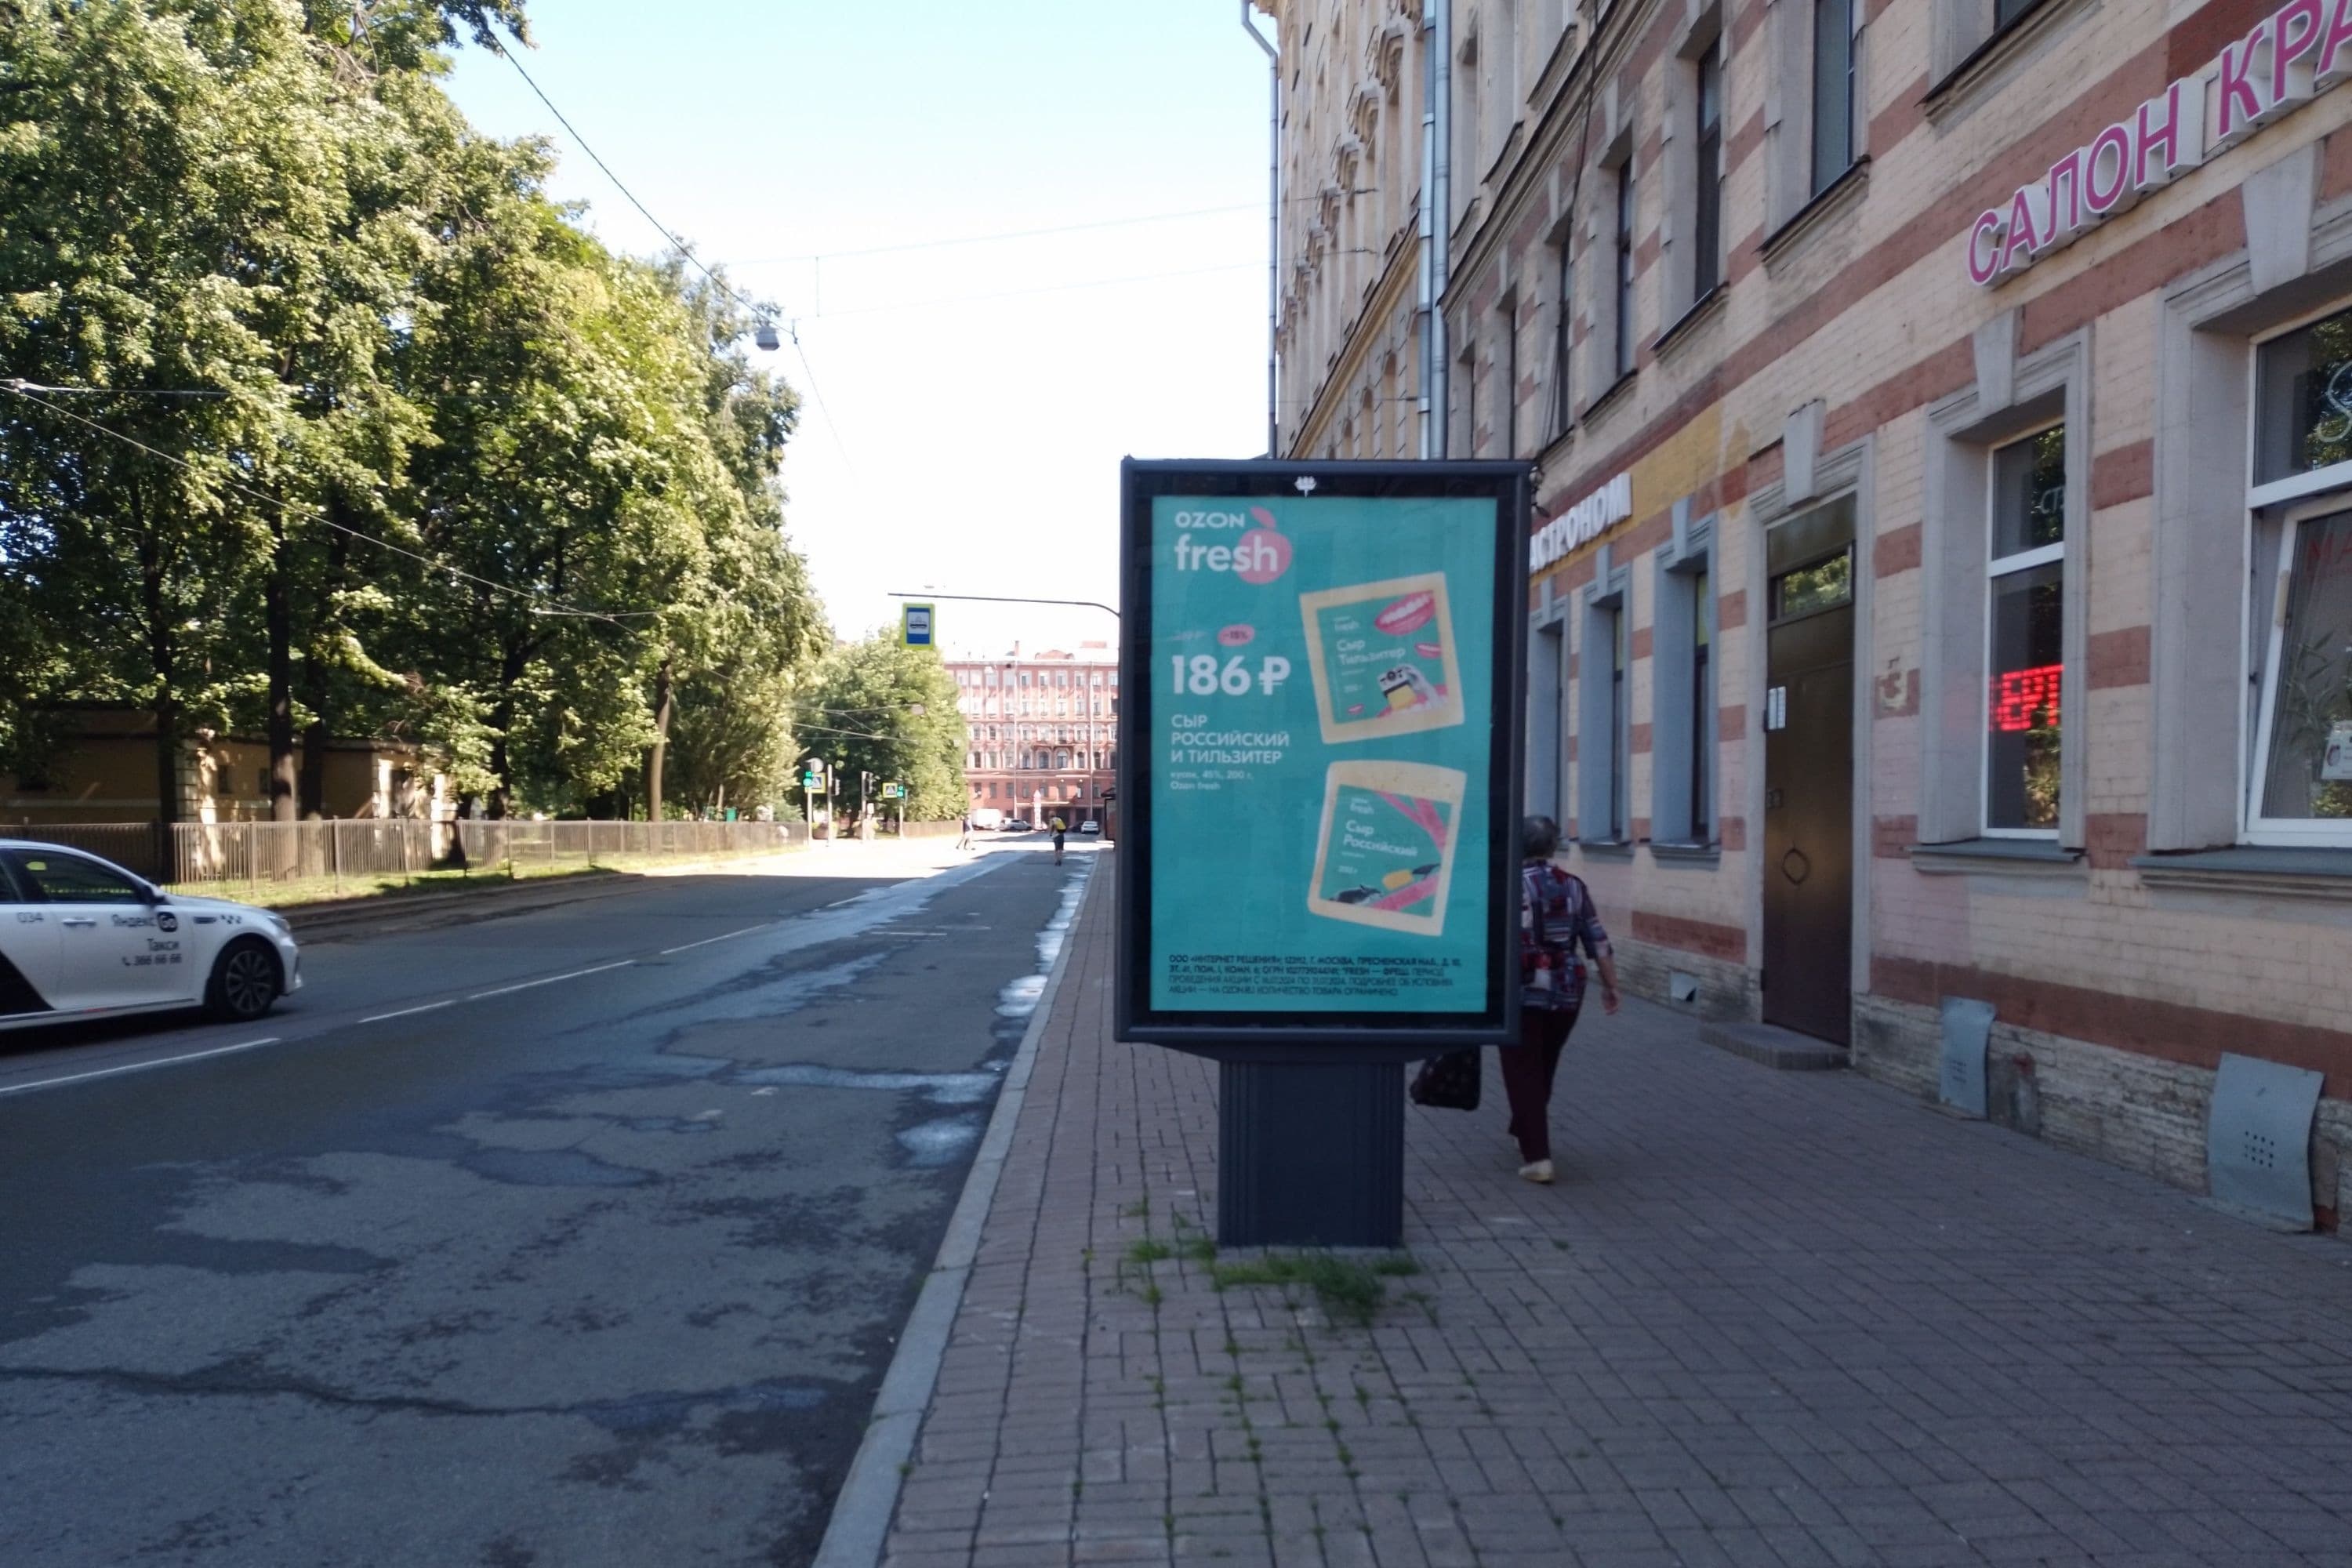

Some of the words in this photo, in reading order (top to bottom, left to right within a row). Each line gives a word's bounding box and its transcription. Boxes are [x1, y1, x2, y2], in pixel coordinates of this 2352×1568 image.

[1968, 79, 2180, 286] САЛОН
[1174, 511, 1246, 528] OZON
[1174, 532, 1279, 572] fresh
[1171, 654, 1252, 696] 186
[1171, 714, 1208, 728] СЫР
[1171, 730, 1290, 747] РОССИЙСКИЙ
[1171, 749, 1184, 764] И
[1188, 749, 1283, 764] ТИЛЬЗИТЕР
[1345, 819, 1374, 837] Сыр
[1343, 833, 1418, 857] Российский
[147, 938, 180, 952] Такси
[1168, 954, 1189, 964] ООО
